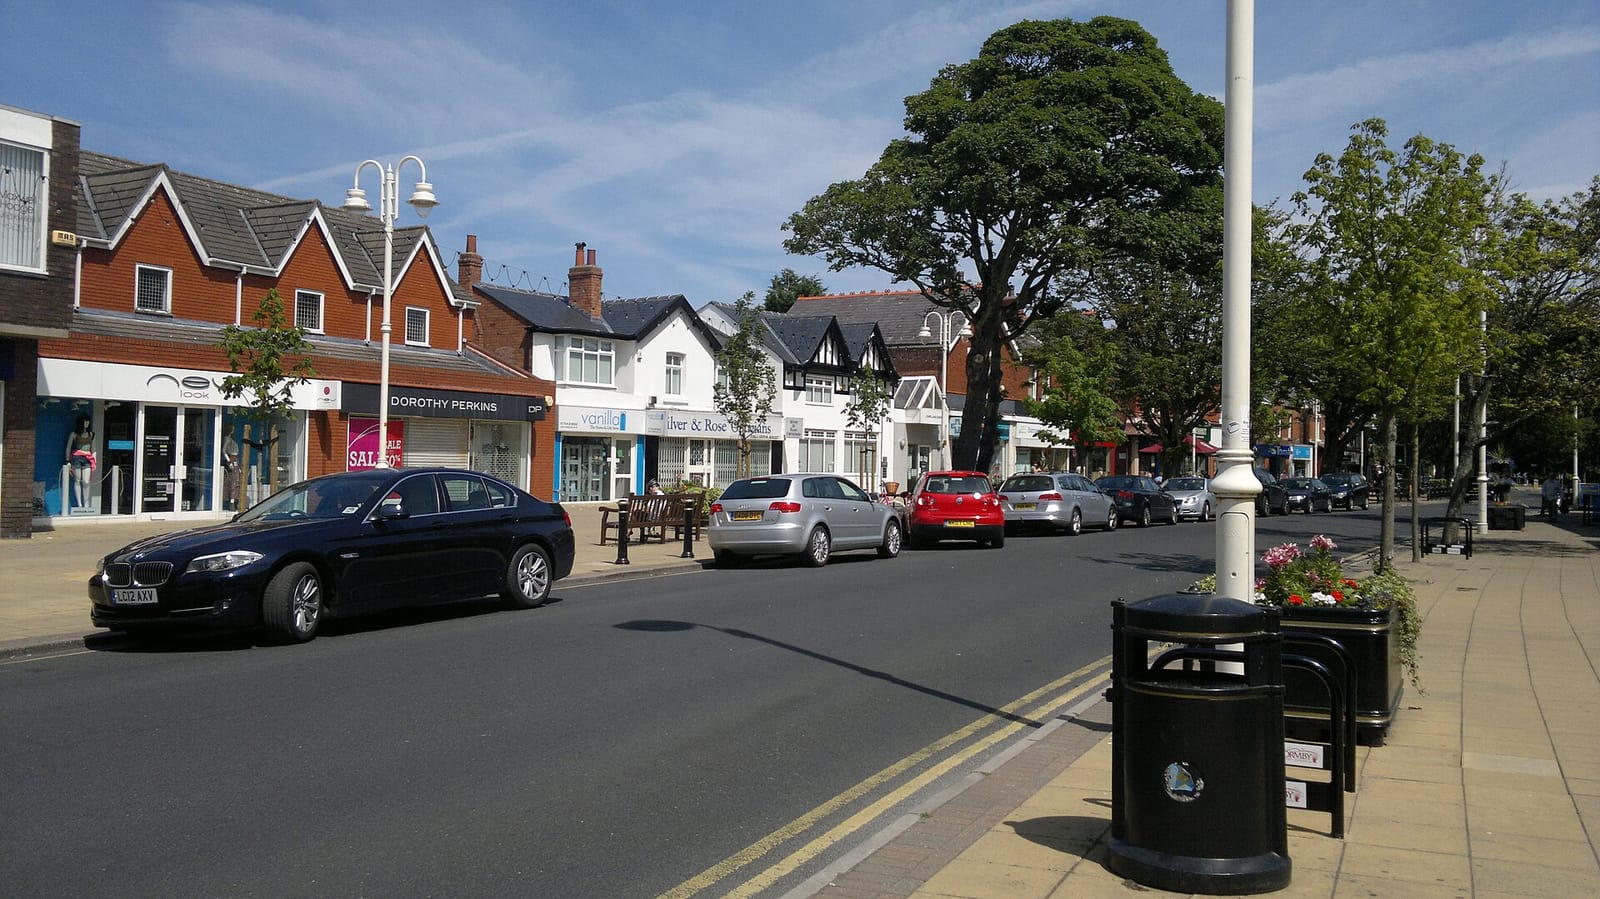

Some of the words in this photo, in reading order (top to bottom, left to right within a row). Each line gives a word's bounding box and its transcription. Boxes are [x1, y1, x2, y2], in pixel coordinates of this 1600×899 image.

[180, 390, 209, 399] look
[391, 396, 449, 409] DOROTHY
[451, 400, 497, 412] PERKINS
[528, 405, 542, 413] DP
[581, 410, 620, 426] vanilla
[667, 415, 688, 430] ilver
[690, 418, 701, 431] &
[704, 418, 727, 432] Rose
[349, 450, 380, 467] SAL
[117, 590, 136, 602] LC12
[137, 590, 153, 602] AXV
